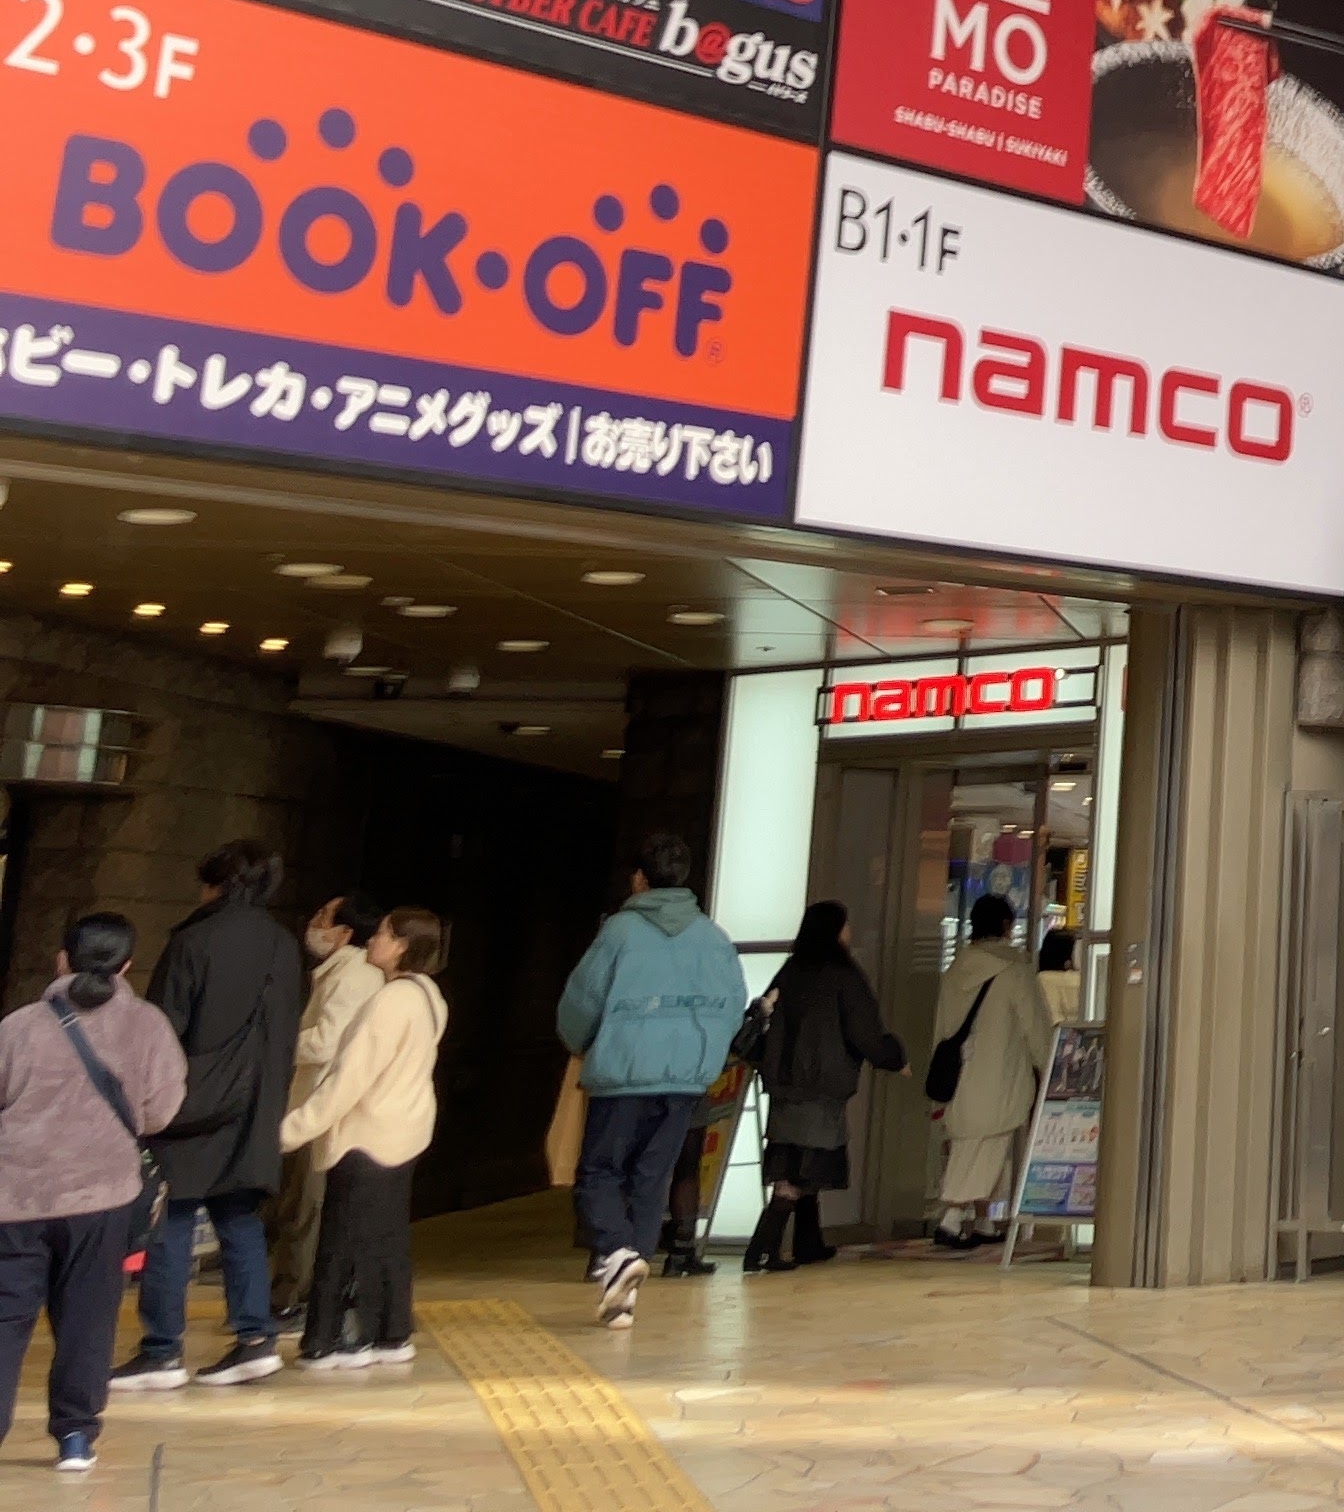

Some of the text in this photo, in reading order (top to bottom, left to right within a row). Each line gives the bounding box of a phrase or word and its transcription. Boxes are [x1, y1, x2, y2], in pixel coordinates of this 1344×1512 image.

[927, 67, 1042, 120] PARADISE
[881, 306, 1295, 465] namco
[581, 411, 775, 487] お売り下さい
[832, 667, 1056, 723] namco
